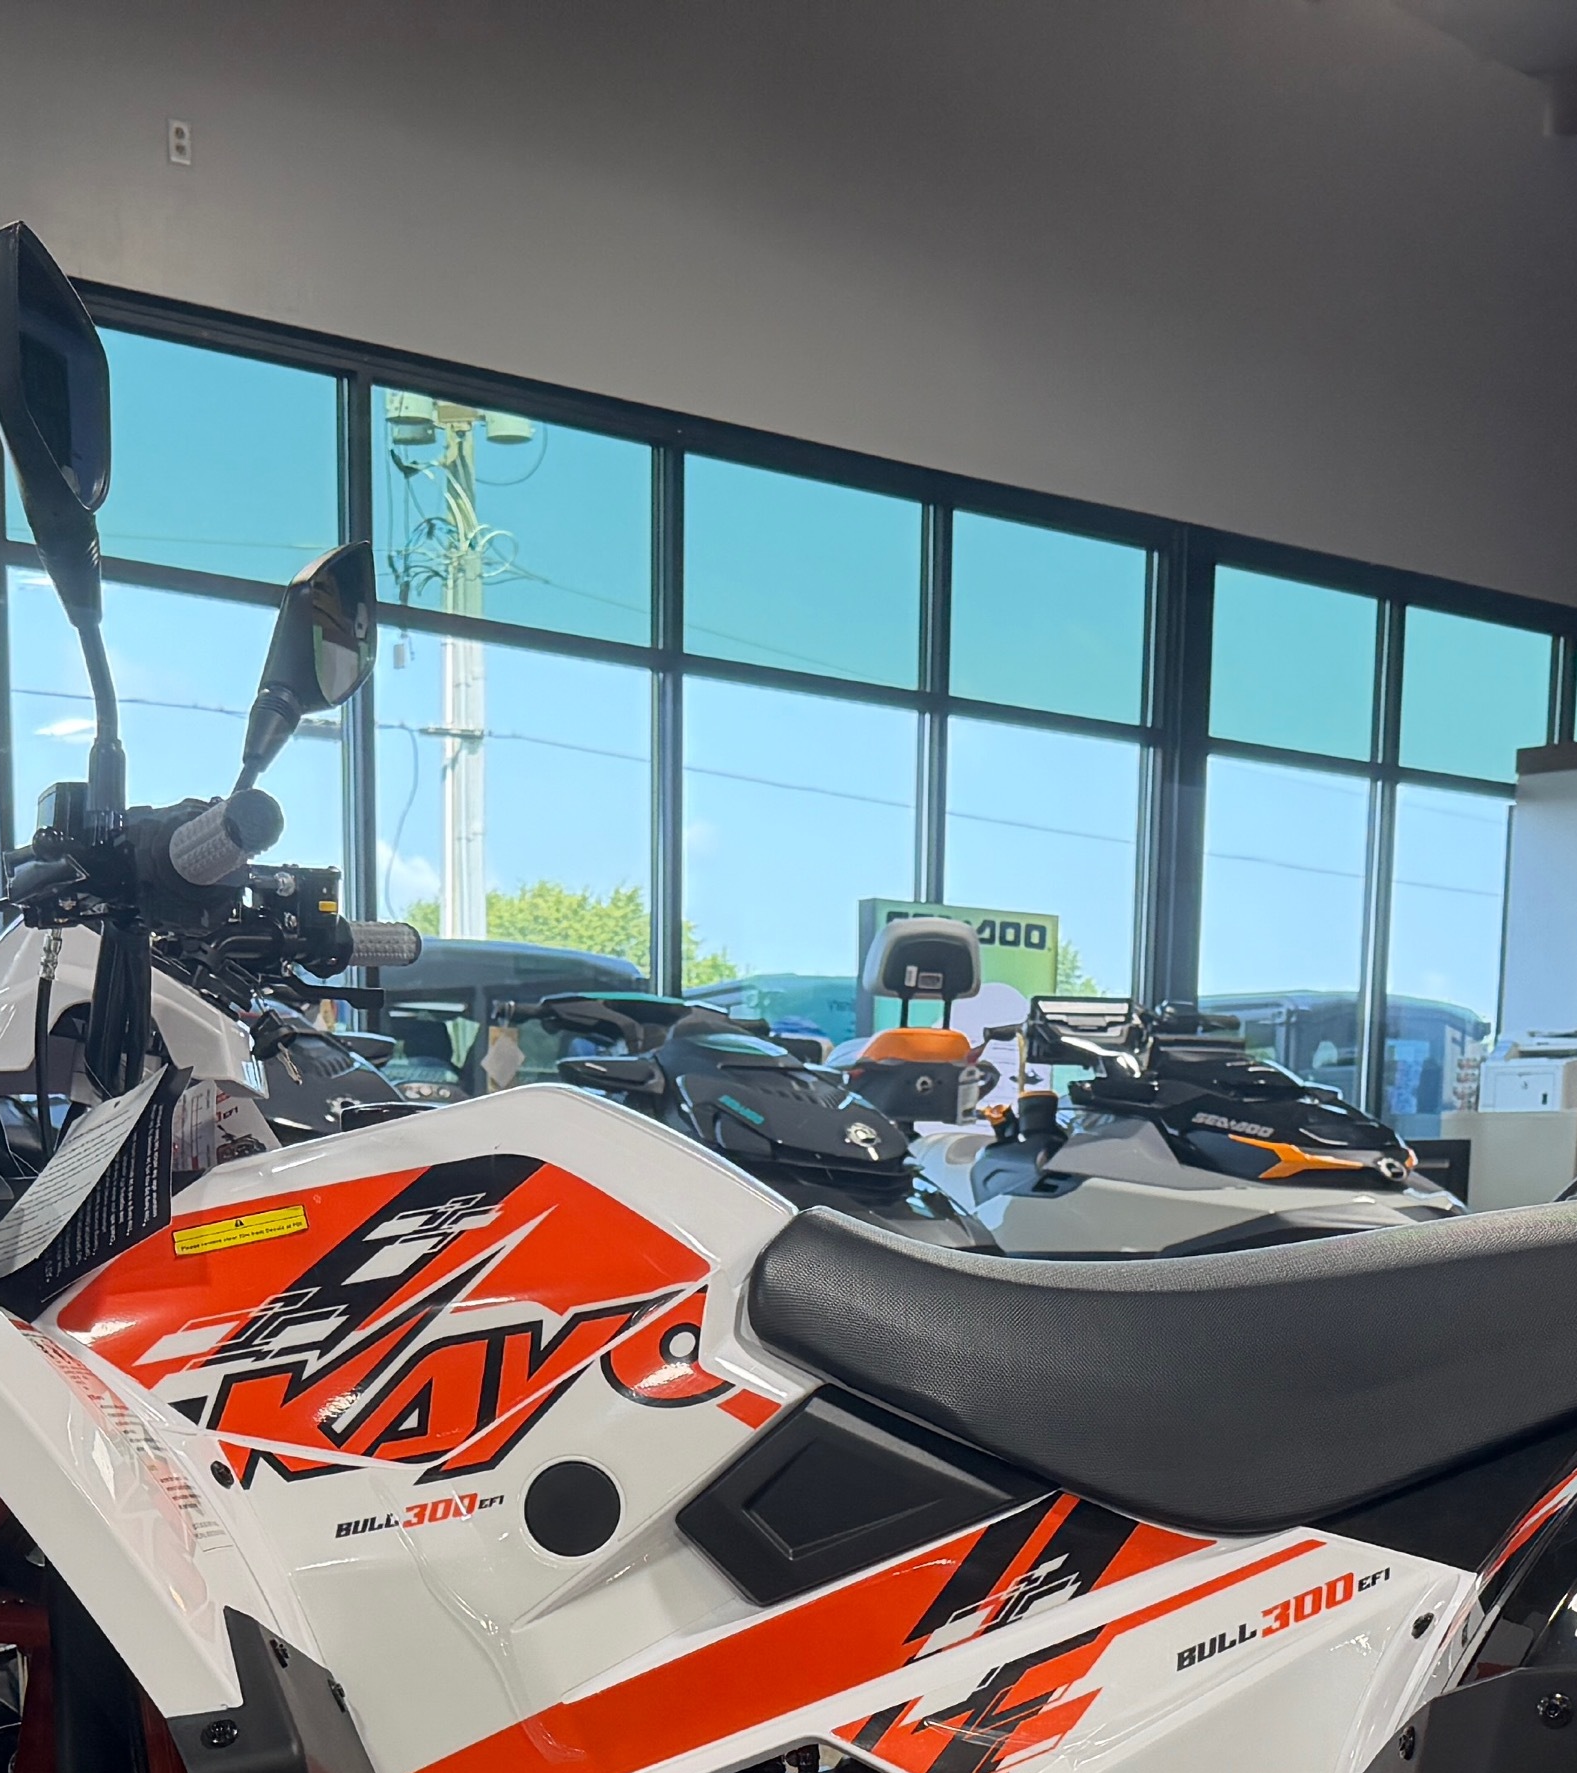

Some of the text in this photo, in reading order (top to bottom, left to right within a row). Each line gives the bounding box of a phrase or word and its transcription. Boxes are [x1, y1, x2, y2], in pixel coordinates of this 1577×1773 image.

[206, 1248, 736, 1490] KAYO
[335, 1492, 505, 1539] BULL 300 EFI
[1176, 1567, 1390, 1671] BULL 300 EFI
